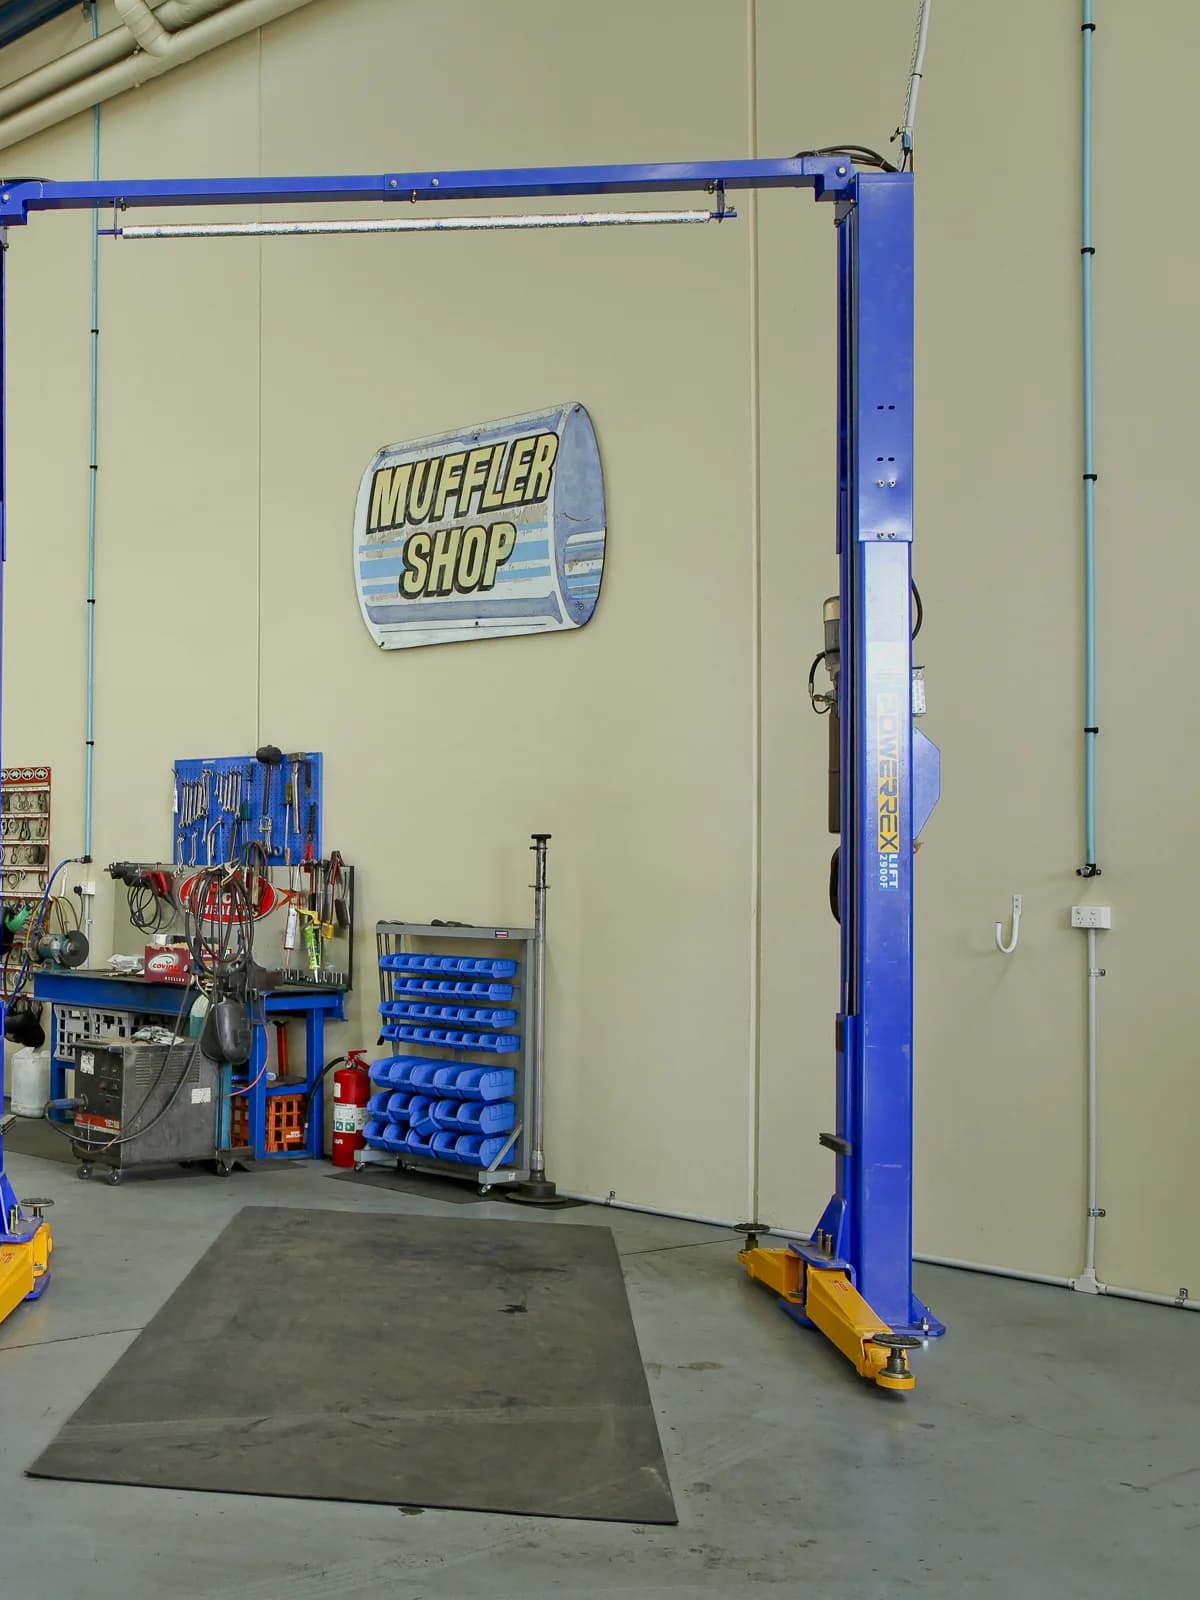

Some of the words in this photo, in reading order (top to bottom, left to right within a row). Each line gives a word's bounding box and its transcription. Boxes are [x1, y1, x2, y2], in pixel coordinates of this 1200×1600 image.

[366, 431, 559, 535] MUFFLER
[399, 521, 517, 599] SHOP
[880, 854, 888, 889] 2900F
[889, 854, 898, 889] LIFT
